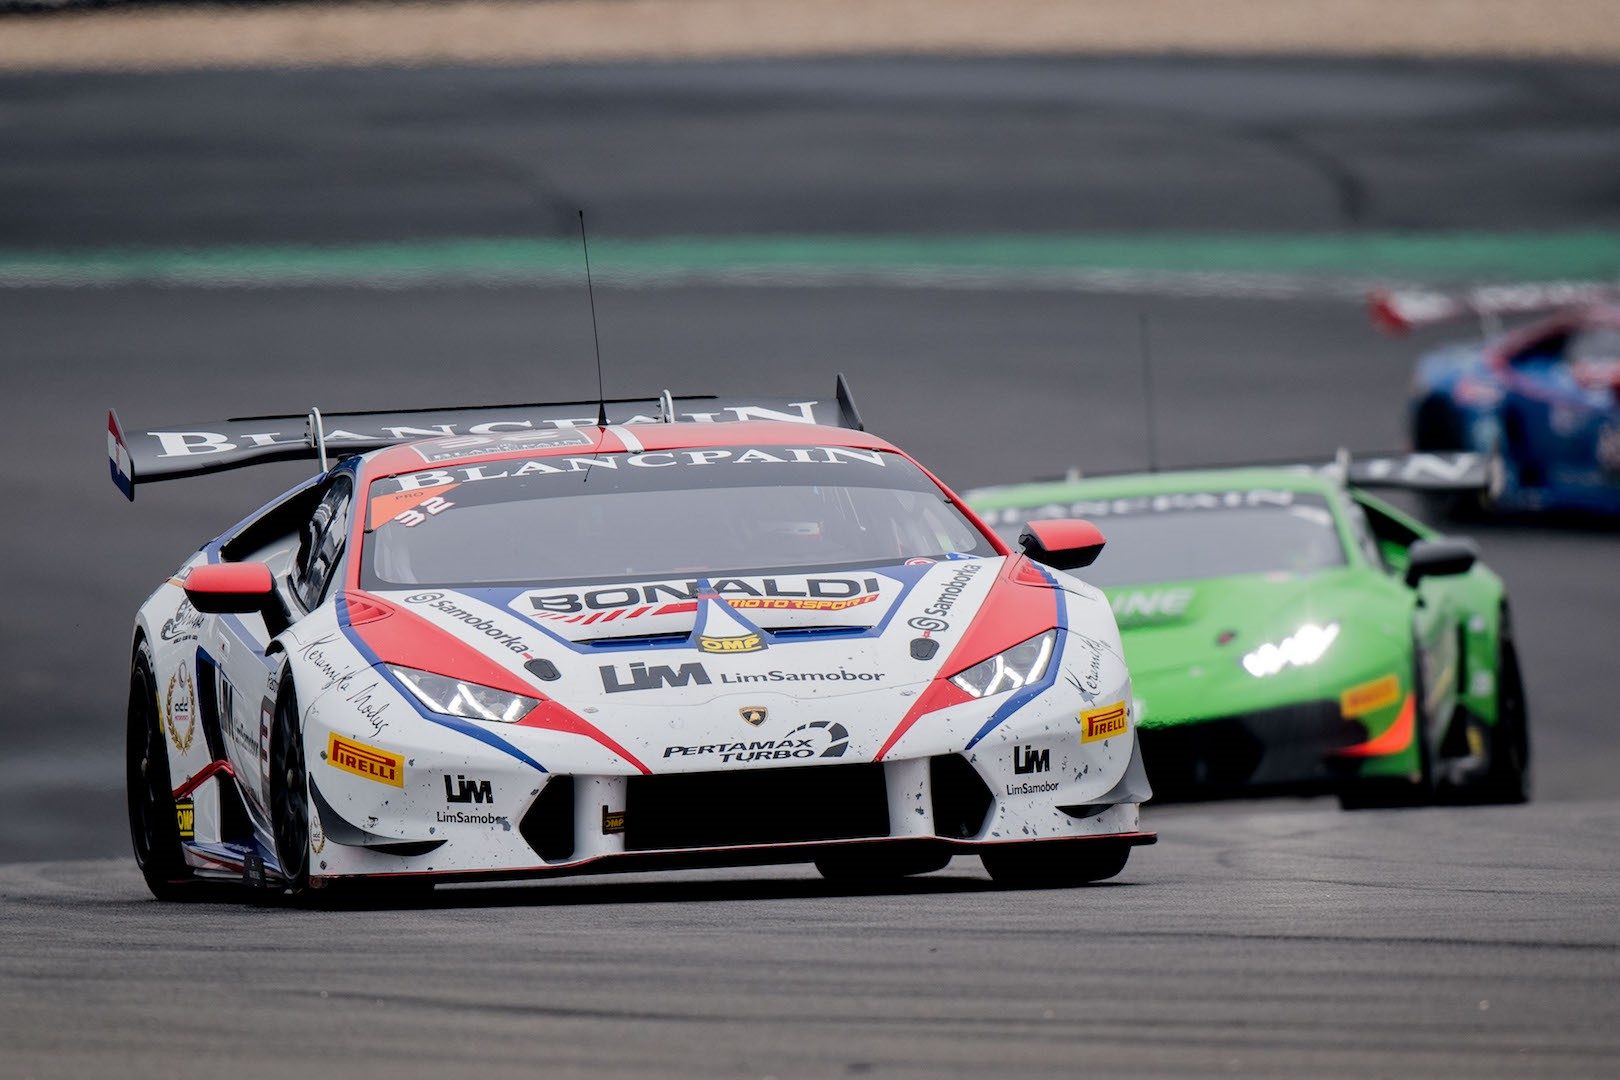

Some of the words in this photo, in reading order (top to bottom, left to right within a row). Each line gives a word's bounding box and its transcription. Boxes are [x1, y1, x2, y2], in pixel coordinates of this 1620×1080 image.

[395, 446, 888, 493] BLANCPAIN
[395, 491, 425, 502] PRO
[394, 496, 457, 528] 32
[529, 577, 880, 614] BONALDI
[923, 562, 983, 618] Samoborka
[726, 594, 880, 611] MOTORSPORT
[430, 599, 530, 655] Samoborka
[701, 635, 762, 652] OMP
[721, 670, 885, 684] LimSamobor
[1088, 708, 1125, 737] PIRELLI
[663, 738, 814, 758] PERTAMAX
[721, 750, 815, 763] TURBO
[332, 739, 397, 781] PIRELLI
[1006, 780, 1060, 796] LimSamobor
[177, 810, 194, 831] OMP
[436, 812, 508, 825] LimSamobor
